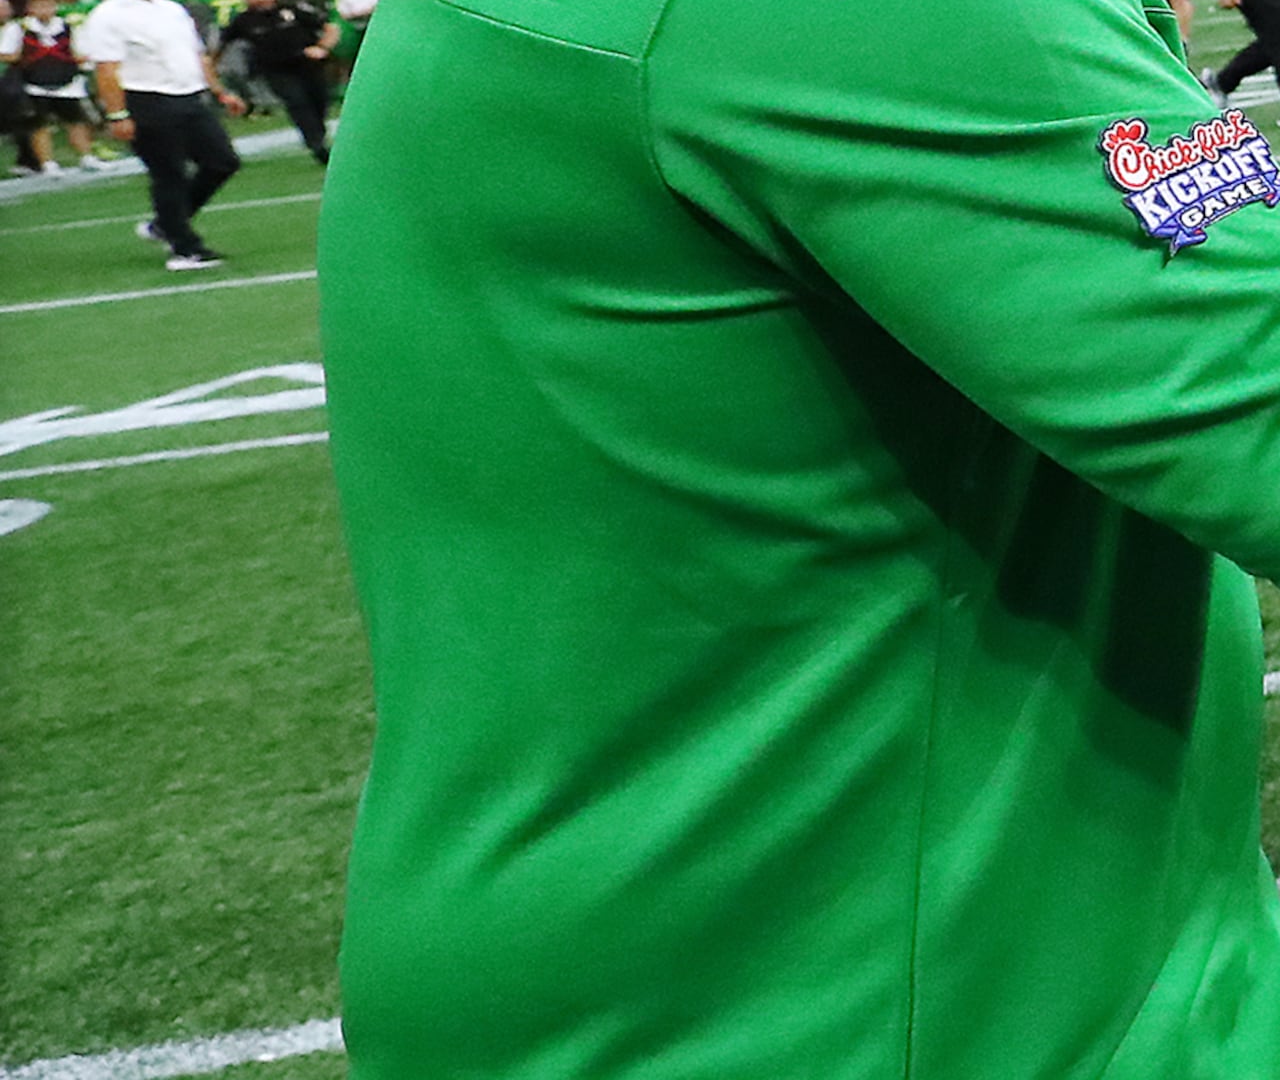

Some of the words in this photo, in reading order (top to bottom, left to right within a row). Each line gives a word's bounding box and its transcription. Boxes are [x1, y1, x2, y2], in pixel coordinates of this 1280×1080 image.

[1112, 110, 1254, 188] Chick-fil-A
[1131, 138, 1276, 230] KICKOFF
[1180, 177, 1269, 228] GAME
